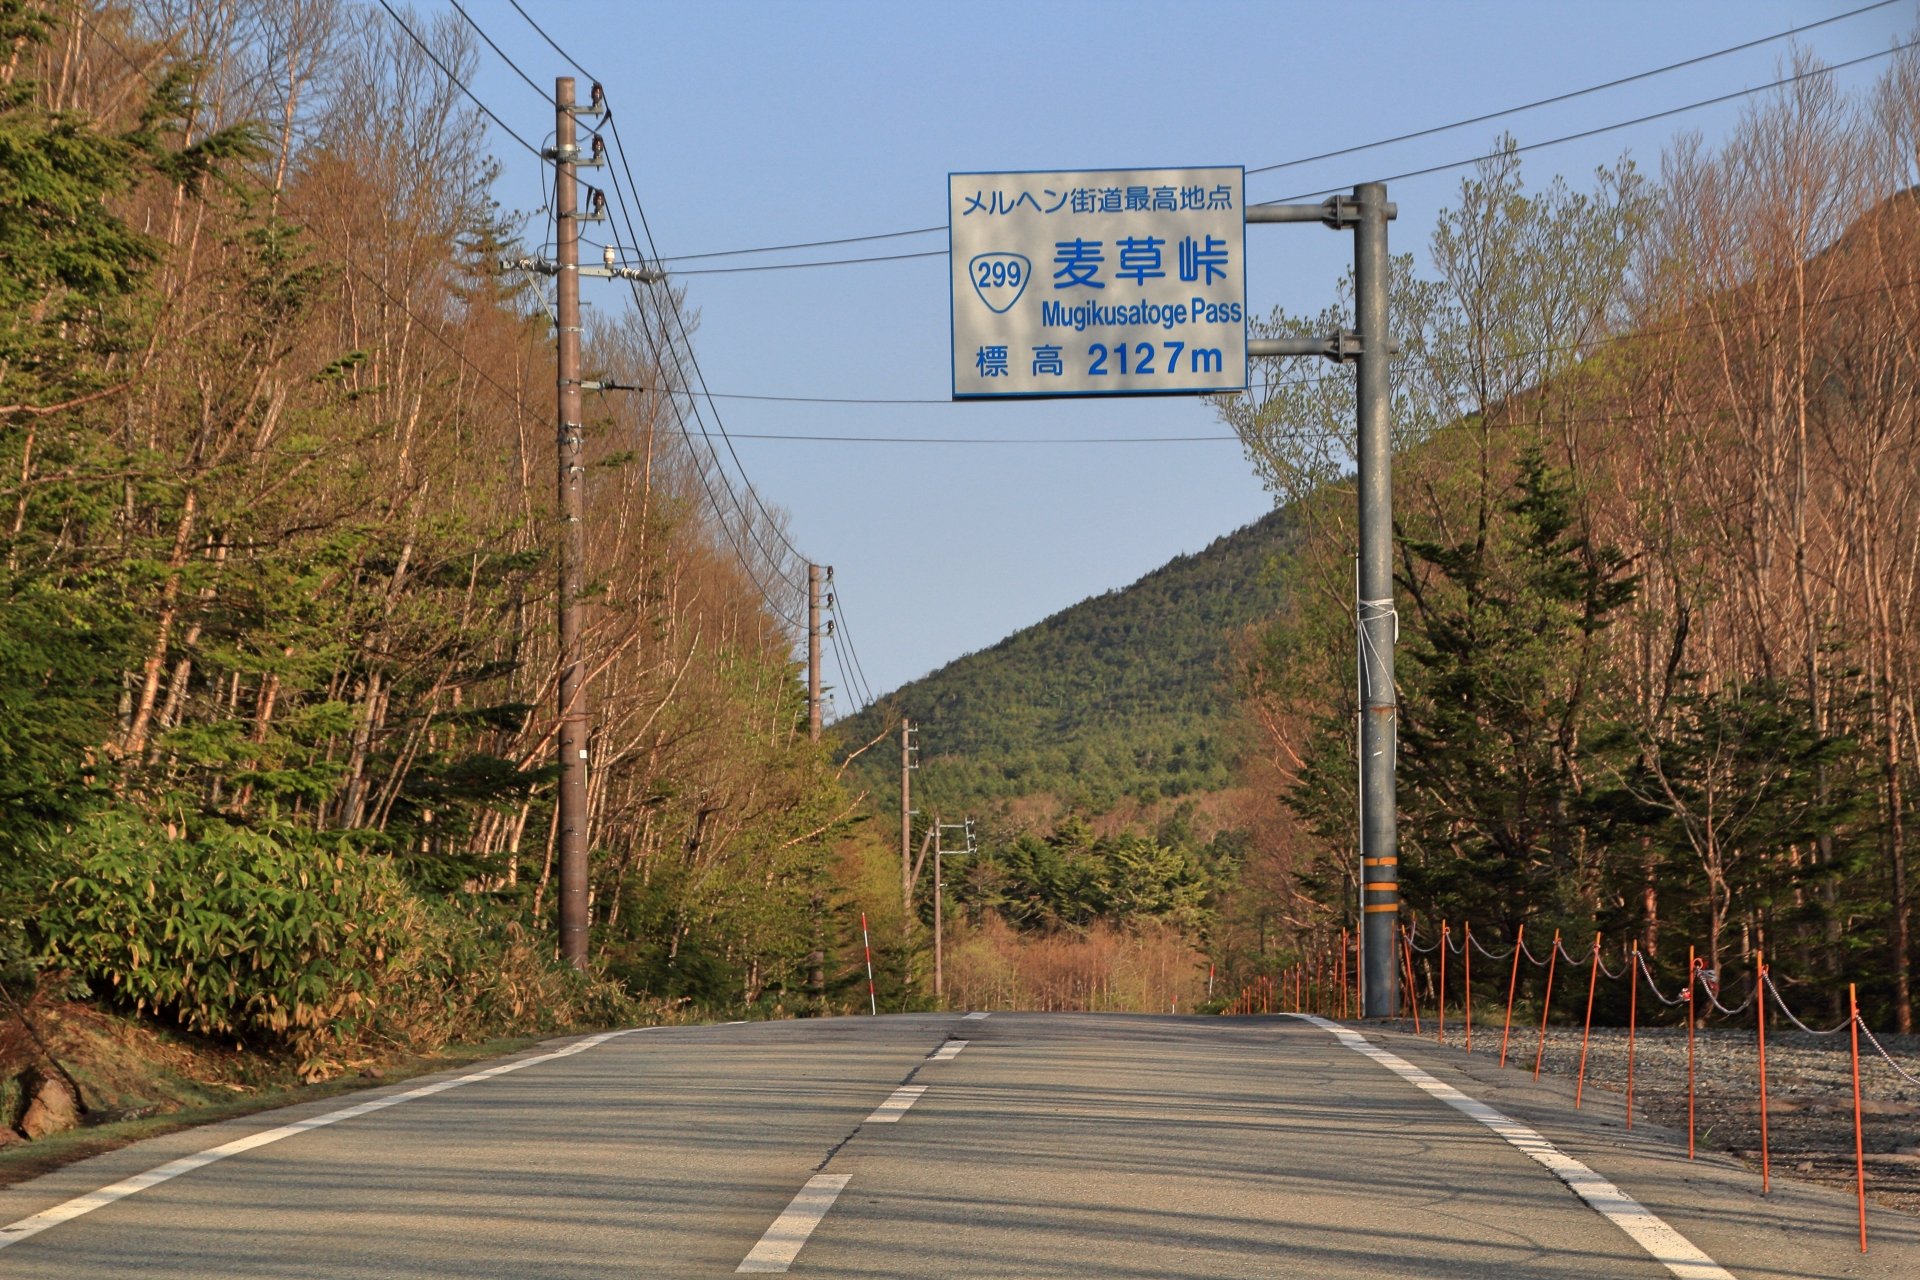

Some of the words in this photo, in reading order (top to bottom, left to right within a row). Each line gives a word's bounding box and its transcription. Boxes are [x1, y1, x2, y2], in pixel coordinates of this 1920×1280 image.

[963, 184, 1232, 215] メルヘン街道最高地点
[978, 261, 1021, 288] 299
[1053, 234, 1229, 289] 麦草峠
[1042, 299, 1187, 332] Mugikusatoge
[1192, 297, 1242, 323] Pass
[1088, 341, 1223, 376] 2127m
